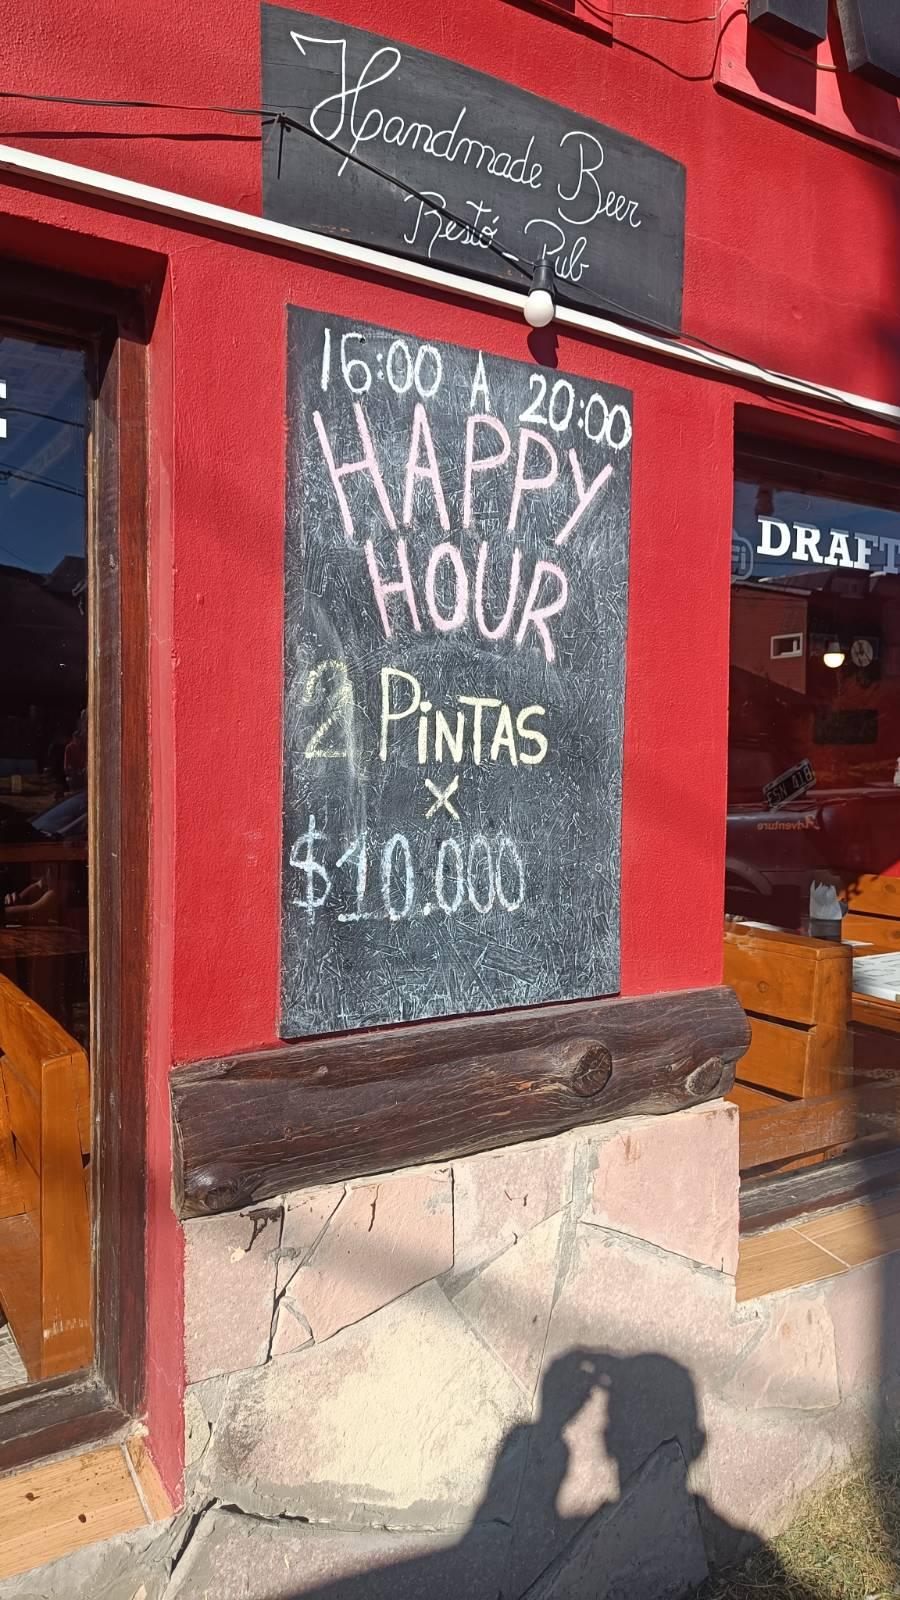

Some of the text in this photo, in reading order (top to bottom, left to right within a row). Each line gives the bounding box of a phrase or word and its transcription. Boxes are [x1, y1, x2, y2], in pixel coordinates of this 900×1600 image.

[290, 31, 641, 228] Handmade Beer
[404, 191, 589, 281] Restó Pub
[321, 328, 632, 449] 16:00 A 20:00
[313, 401, 613, 546] HAPPY
[365, 539, 568, 663] HOUR
[757, 515, 900, 574] DRAFT
[303, 659, 352, 759] 2
[289, 815, 525, 925] $10.000
